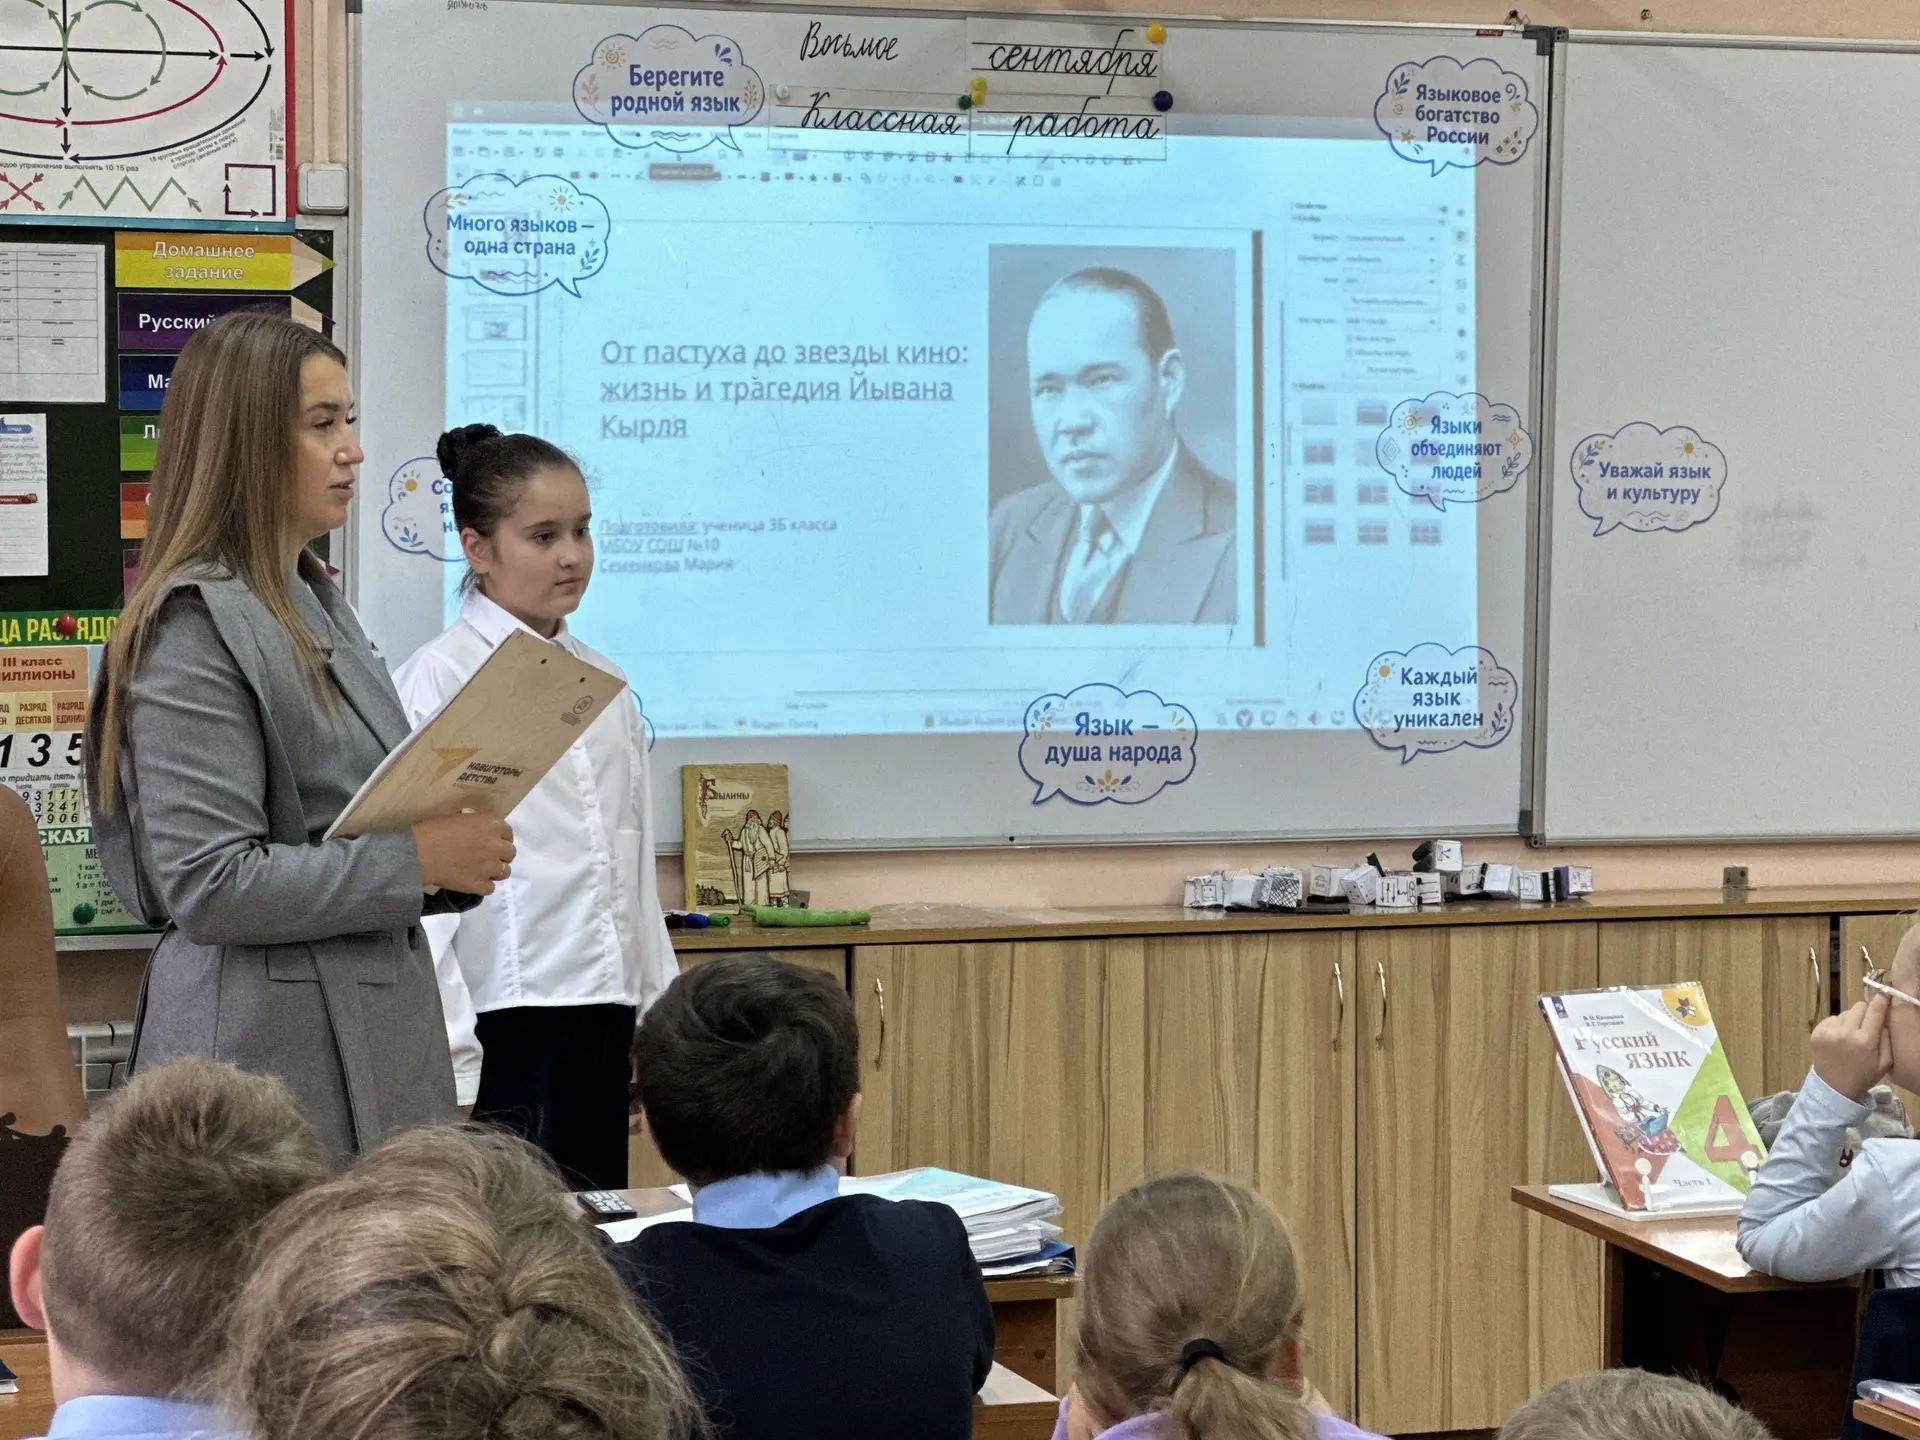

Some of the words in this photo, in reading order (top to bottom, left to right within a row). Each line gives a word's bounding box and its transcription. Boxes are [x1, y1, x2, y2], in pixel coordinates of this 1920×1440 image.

[800, 21, 899, 61] Восьмое
[989, 29, 1158, 94] сентября
[629, 64, 724, 92] Берегите
[1416, 84, 1501, 103] Языковое
[611, 91, 684, 116] родной
[691, 98, 740, 112] язык
[801, 92, 962, 134] Классная
[1415, 104, 1500, 124] богатство
[1007, 97, 1161, 155] работа
[1427, 126, 1488, 144] России
[447, 215, 505, 232] Много
[510, 219, 577, 232] языков
[153, 242, 255, 259] Домашнее
[464, 241, 508, 256] одна
[514, 241, 576, 259] страна
[164, 266, 244, 281] задание
[601, 340, 637, 364] От
[644, 344, 746, 369] пастуха
[754, 344, 786, 367] до
[795, 344, 888, 367] звезды
[897, 344, 968, 365] кино:
[600, 381, 687, 401] жизнь
[696, 381, 712, 401] и
[720, 380, 839, 405] трагедия
[850, 370, 953, 401] Йывана
[601, 414, 687, 443] Кырля
[1431, 416, 1482, 434] Языки
[1411, 442, 1502, 458] объединяют
[1431, 462, 1482, 480] людей
[1599, 462, 1663, 479] Уважай
[1669, 466, 1711, 479] язык
[1607, 488, 1616, 499] и
[1623, 488, 1700, 504] культуру
[702, 522, 765, 535] ученица
[769, 518, 787, 531] 3Б
[790, 520, 837, 532] класса
[647, 538, 684, 553] СОШ
[27, 617, 117, 641] РАЗЯДО
[21, 658, 63, 666] класс
[1401, 667, 1477, 686] Каждый
[20, 703, 47, 712] РАЗРЯД
[57, 702, 84, 711] РАЗРЯД
[1413, 693, 1460, 707] язык
[16, 716, 51, 725] ДЕСЯТКОВ
[56, 715, 85, 723] ЕДИНИЦ
[1075, 712, 1133, 736] Язык
[1394, 713, 1483, 732] уникален
[27, 733, 51, 767] 3
[1045, 746, 1101, 767] душа
[1109, 746, 1182, 766] народа
[8, 773, 52, 783] тридцать
[456, 773, 498, 784] ДЕТСТВА
[467, 762, 524, 777] НАВИГАТОРЫ
[1626, 1050, 1692, 1069] ЯЗЫК
[1704, 1095, 1763, 1162] 4
